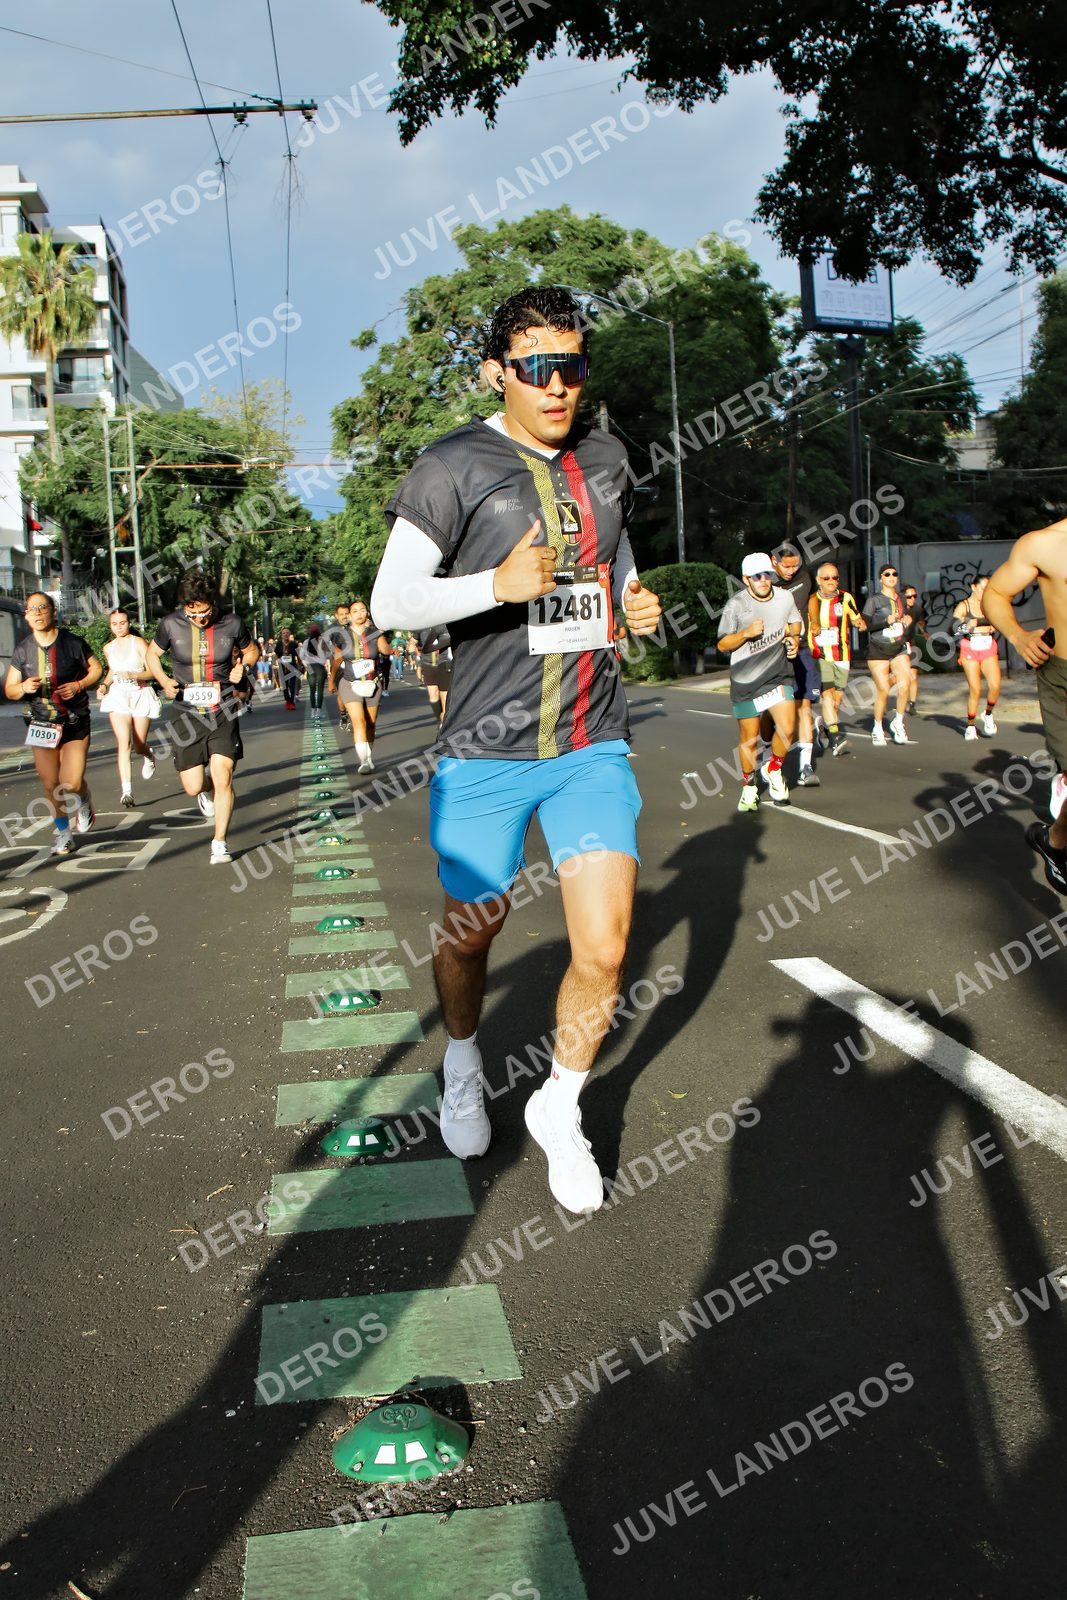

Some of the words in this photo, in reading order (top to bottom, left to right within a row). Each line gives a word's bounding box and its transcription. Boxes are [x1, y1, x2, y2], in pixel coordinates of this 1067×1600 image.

[941, 560, 982, 575] TOY
[534, 592, 602, 624] 12481
[189, 691, 213, 701] 9559
[30, 728, 57, 740] 10301
